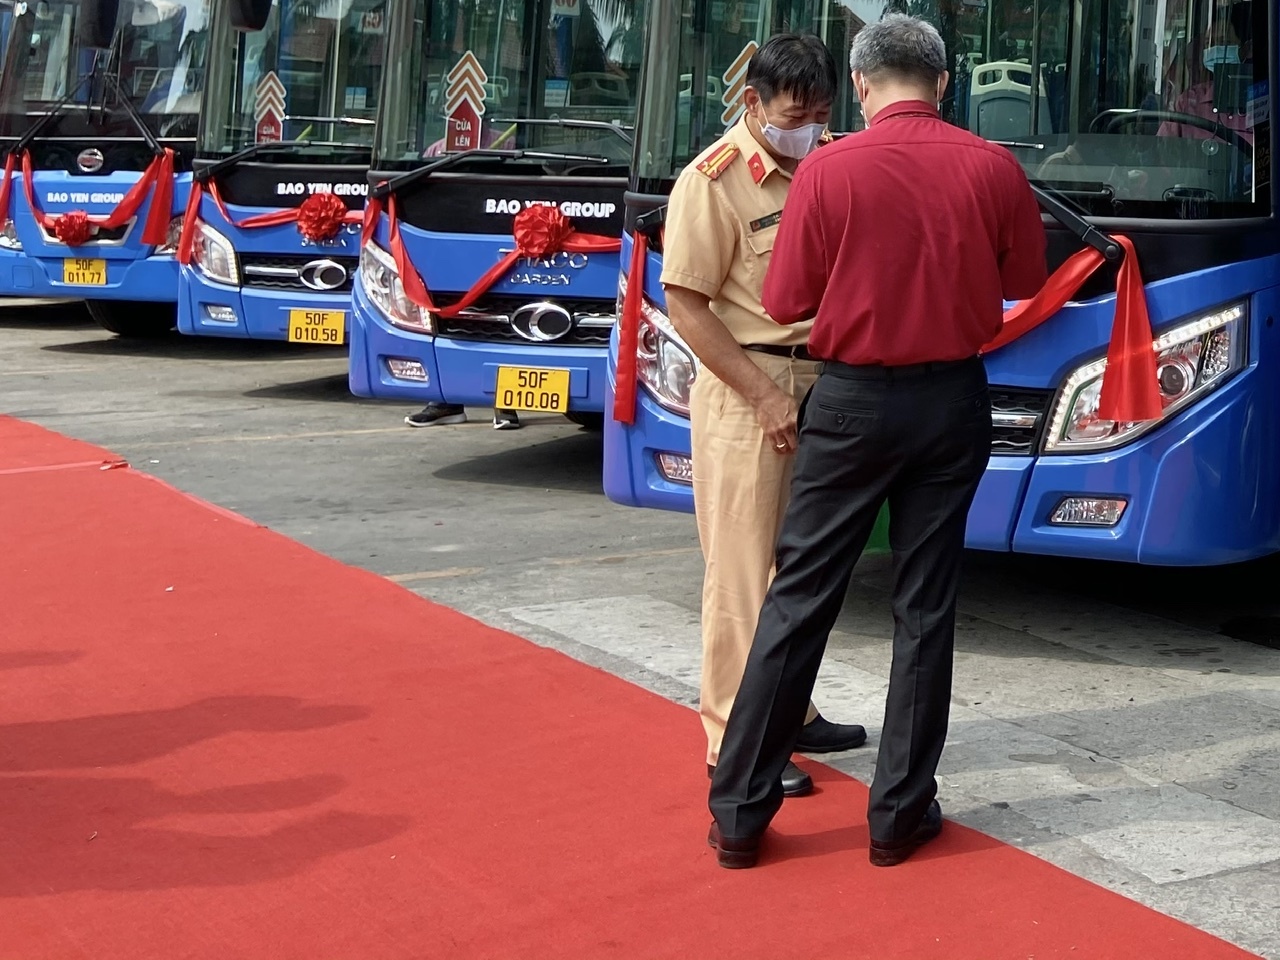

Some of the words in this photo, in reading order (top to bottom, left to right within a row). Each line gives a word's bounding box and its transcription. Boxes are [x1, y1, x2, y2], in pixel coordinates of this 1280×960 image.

[277, 183, 305, 195] BAO
[334, 184, 369, 196] GROU
[47, 192, 68, 203] BAO
[70, 192, 89, 203] YEN
[91, 193, 124, 204] GROUP
[485, 198, 521, 214] BAO
[560, 202, 616, 218] GROUP
[75, 259, 93, 271] 50F
[68, 272, 102, 284] 011.77
[305, 312, 329, 326] 50F
[295, 327, 338, 342] 010.58
[518, 370, 549, 389] 50F
[503, 390, 560, 410] 010.08
